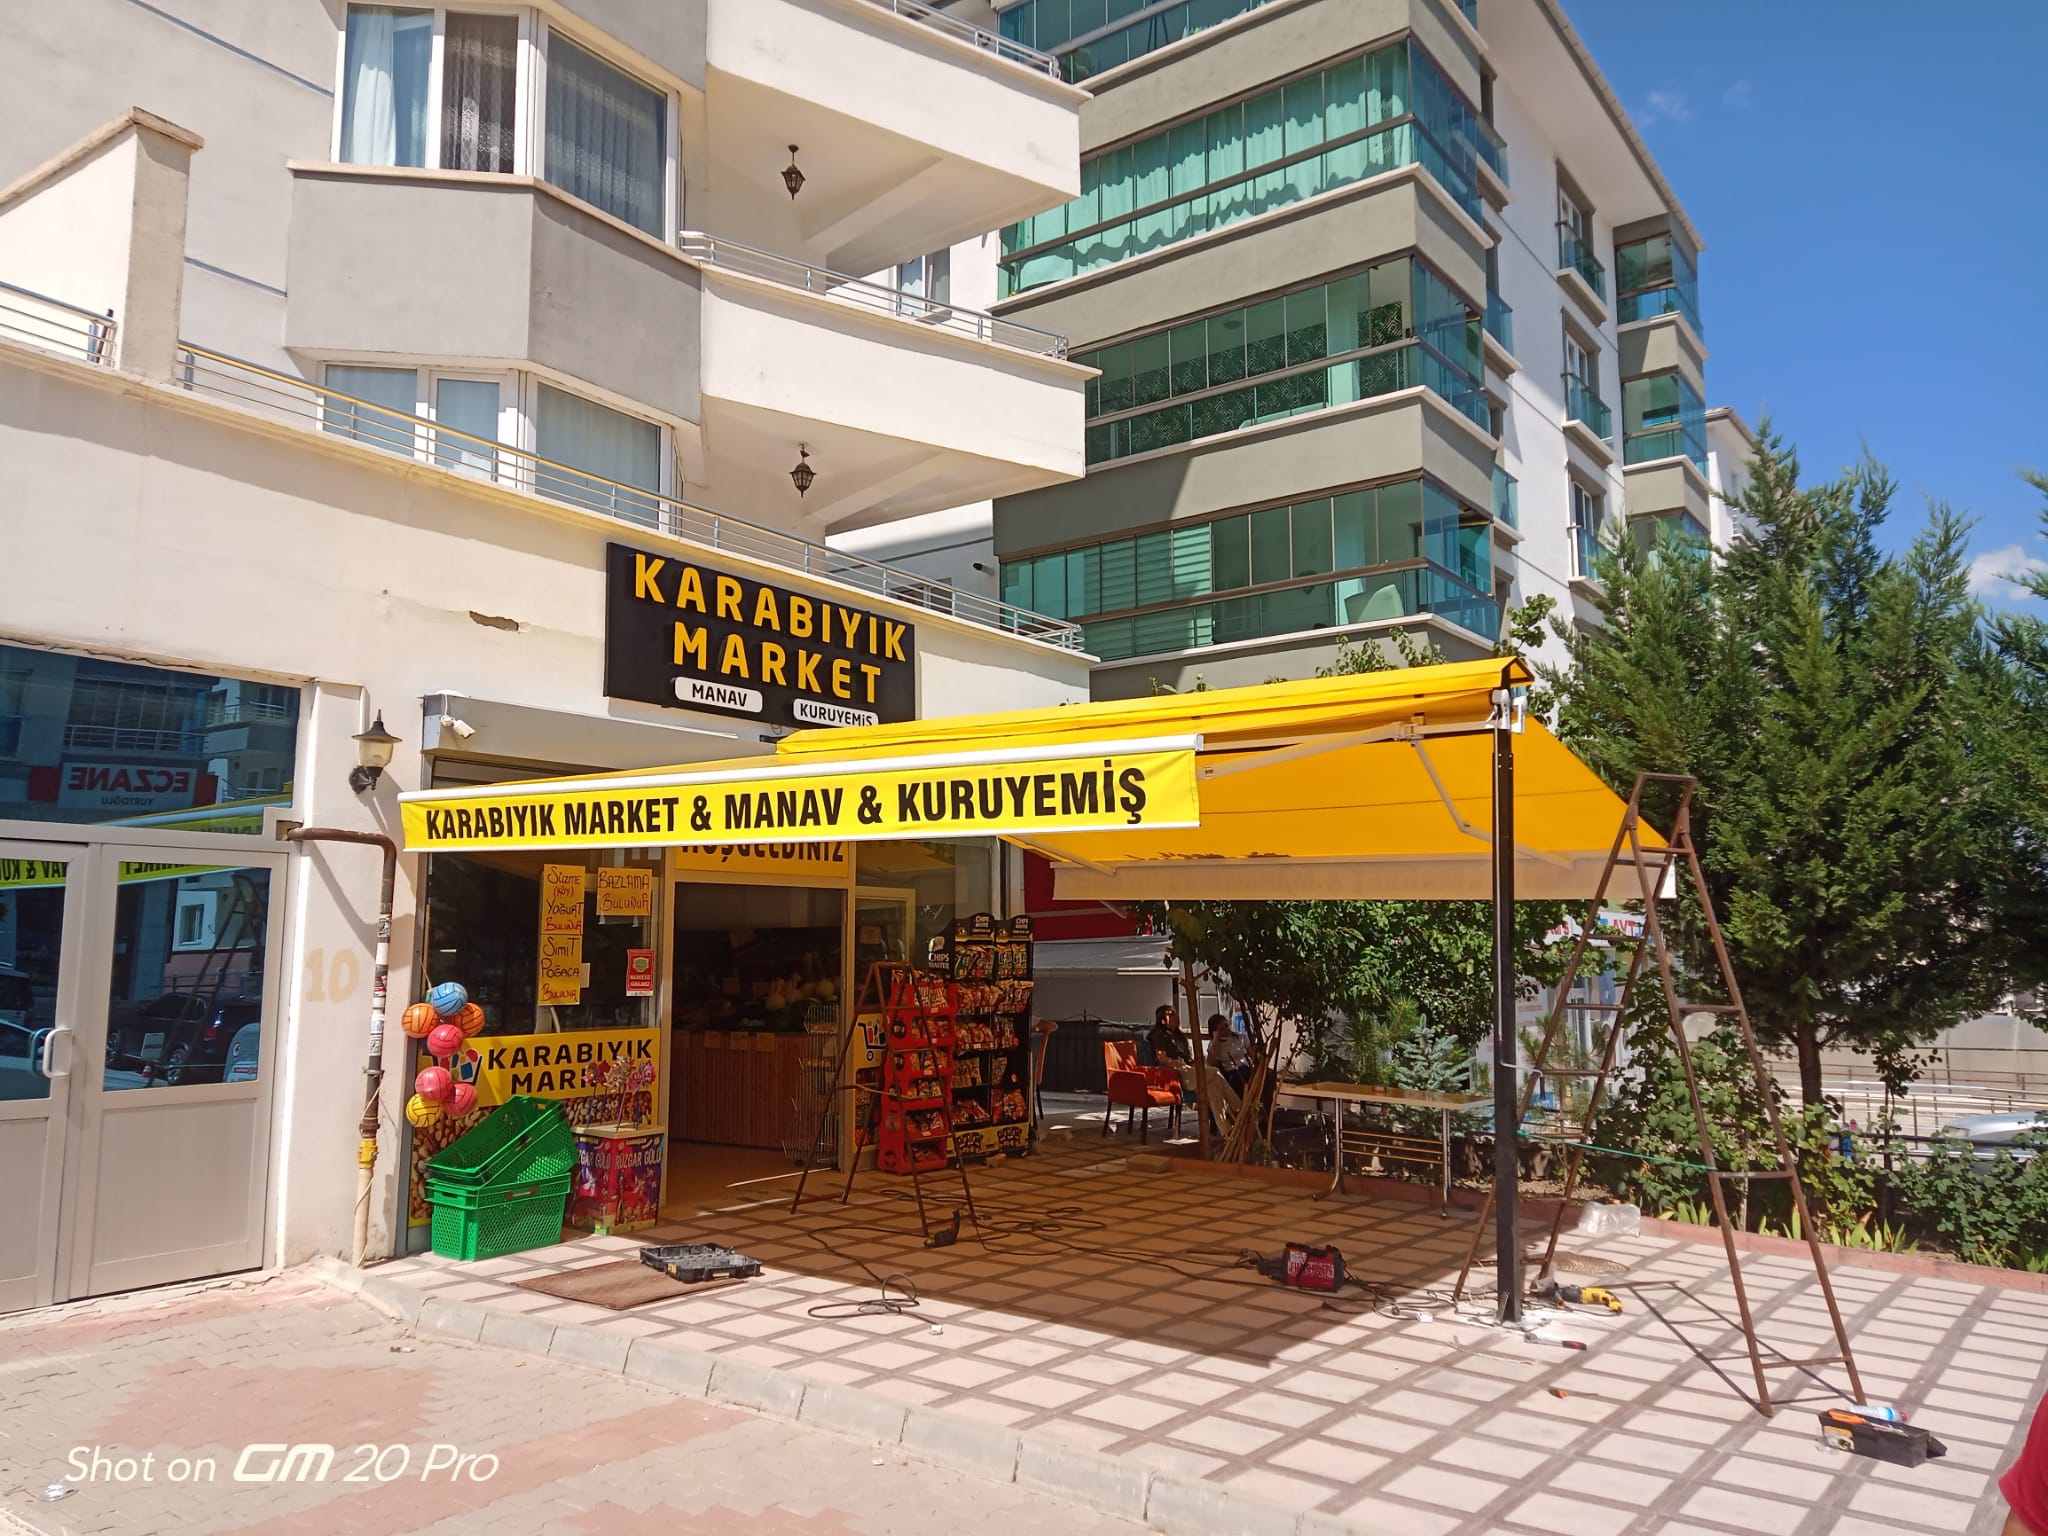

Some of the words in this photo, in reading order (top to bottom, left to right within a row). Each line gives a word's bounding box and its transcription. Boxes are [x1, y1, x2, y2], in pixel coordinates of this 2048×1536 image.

[635, 553, 906, 662] KARABIYIK
[674, 621, 881, 704] MARKET
[692, 683, 748, 708] MANAV
[426, 804, 555, 840] KARABIYIK
[565, 797, 680, 835] MARKET
[690, 795, 713, 832] &
[724, 787, 844, 830] MANAV
[857, 784, 883, 825] &
[898, 759, 1147, 825] KURUYEMİŞ
[305, 948, 360, 1004] 10
[488, 1038, 654, 1070] KARABIYIK
[511, 1068, 597, 1095] MAR
